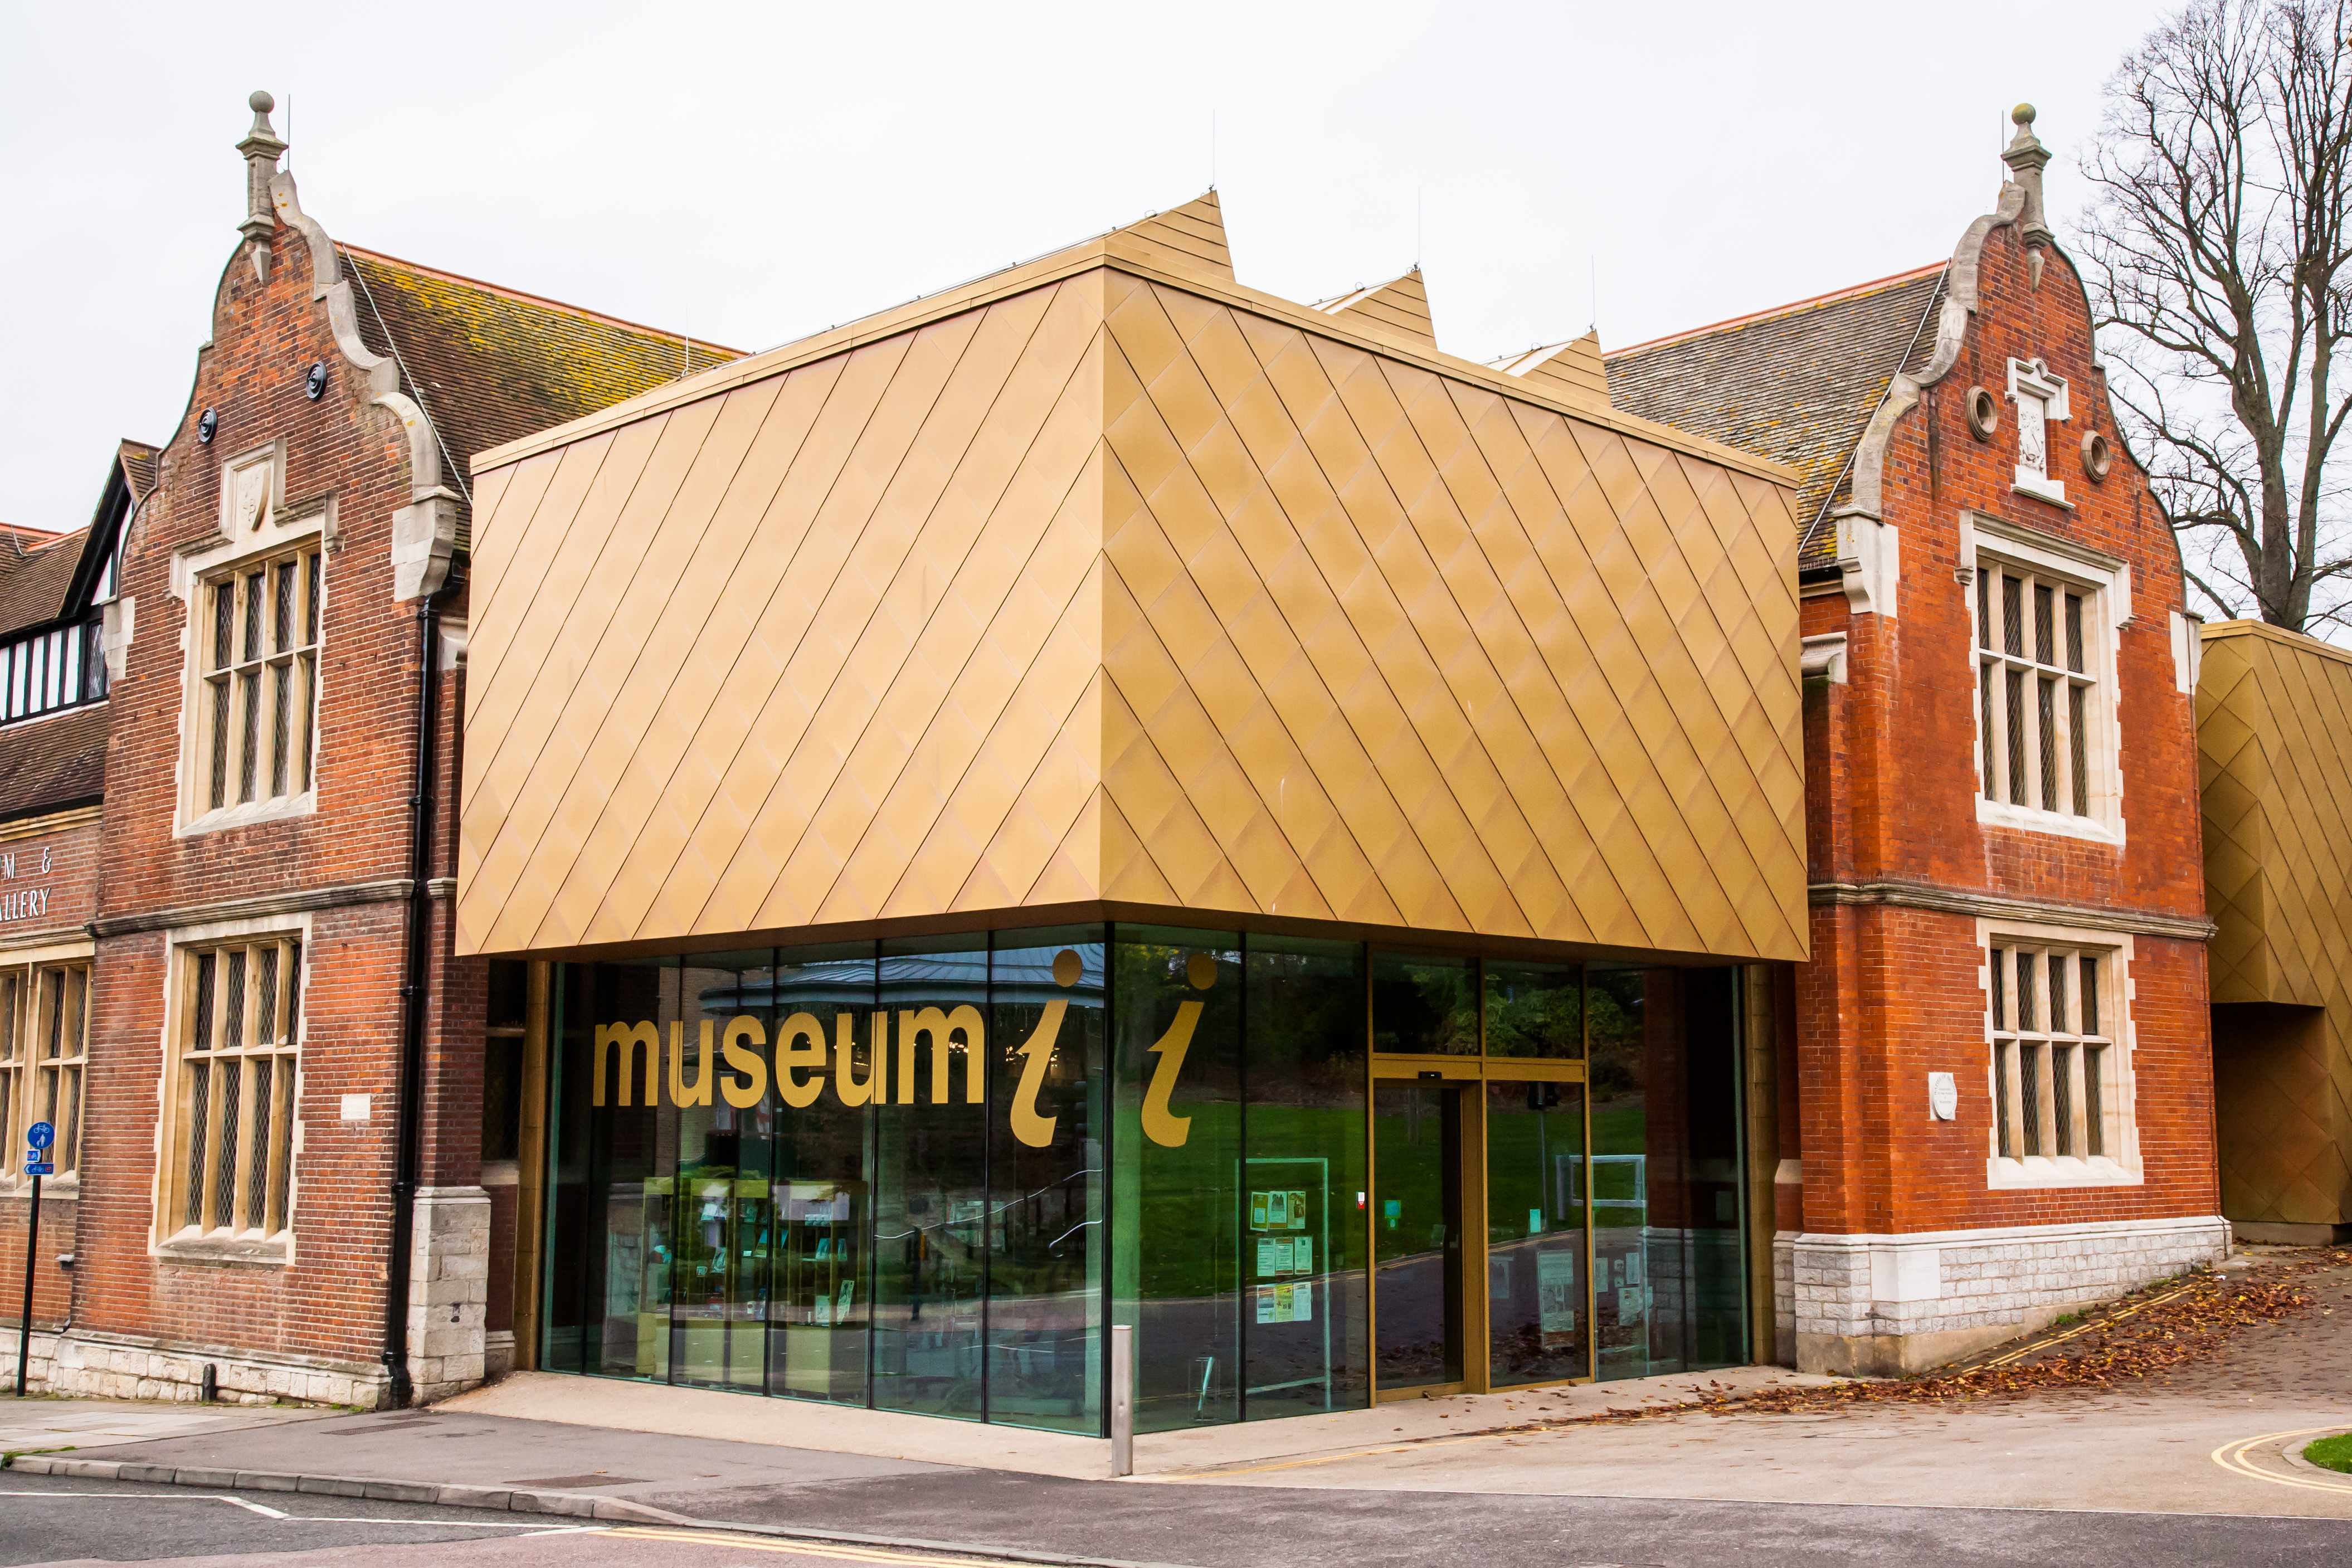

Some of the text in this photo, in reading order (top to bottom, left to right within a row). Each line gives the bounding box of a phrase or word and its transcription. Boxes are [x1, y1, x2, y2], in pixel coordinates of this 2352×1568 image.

[0, 888, 51, 921] LLERY
[42, 847, 52, 874] &
[592, 949, 1083, 1147] museum i
[1141, 953, 1218, 1147] i
